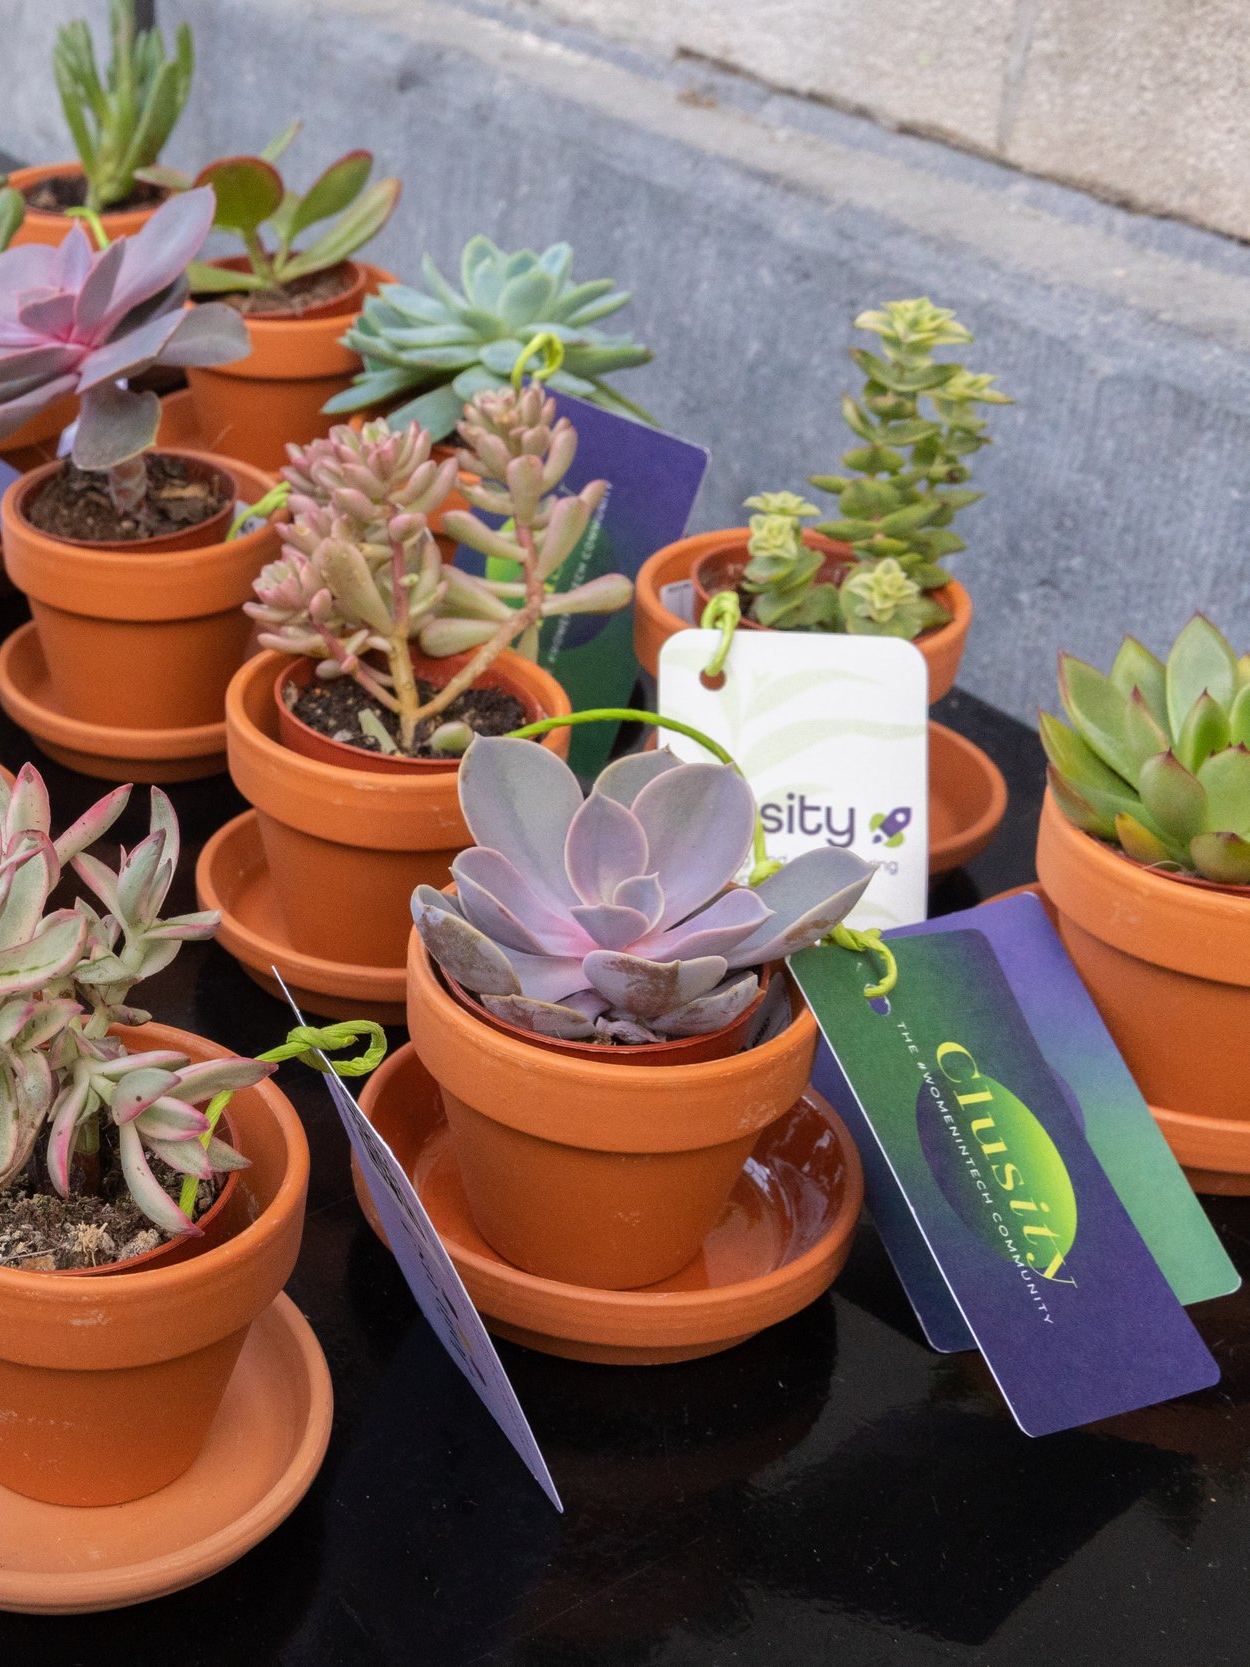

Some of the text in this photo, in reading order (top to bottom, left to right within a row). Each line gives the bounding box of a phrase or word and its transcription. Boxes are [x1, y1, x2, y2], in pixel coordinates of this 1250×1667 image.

[760, 792, 855, 849] sity
[897, 1022, 919, 1054] THE
[992, 1212, 1054, 1325] COMMUNITY
[936, 1041, 1078, 1289] Clusity
